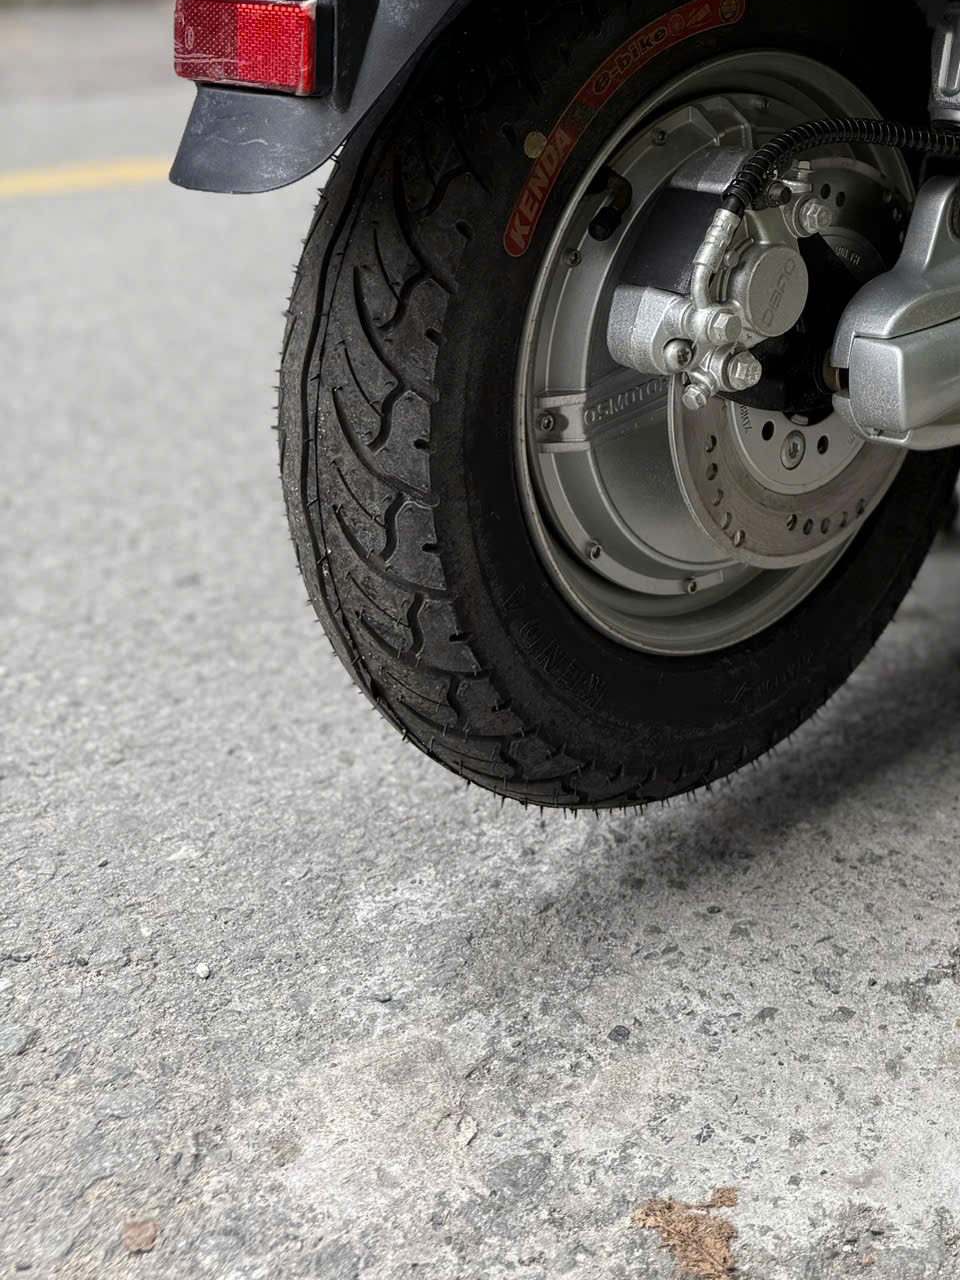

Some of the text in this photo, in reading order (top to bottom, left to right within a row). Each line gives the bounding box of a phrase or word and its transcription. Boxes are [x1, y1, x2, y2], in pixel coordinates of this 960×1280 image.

[508, 24, 668, 250] KENDA e-bike
[762, 257, 797, 328] DIBAO
